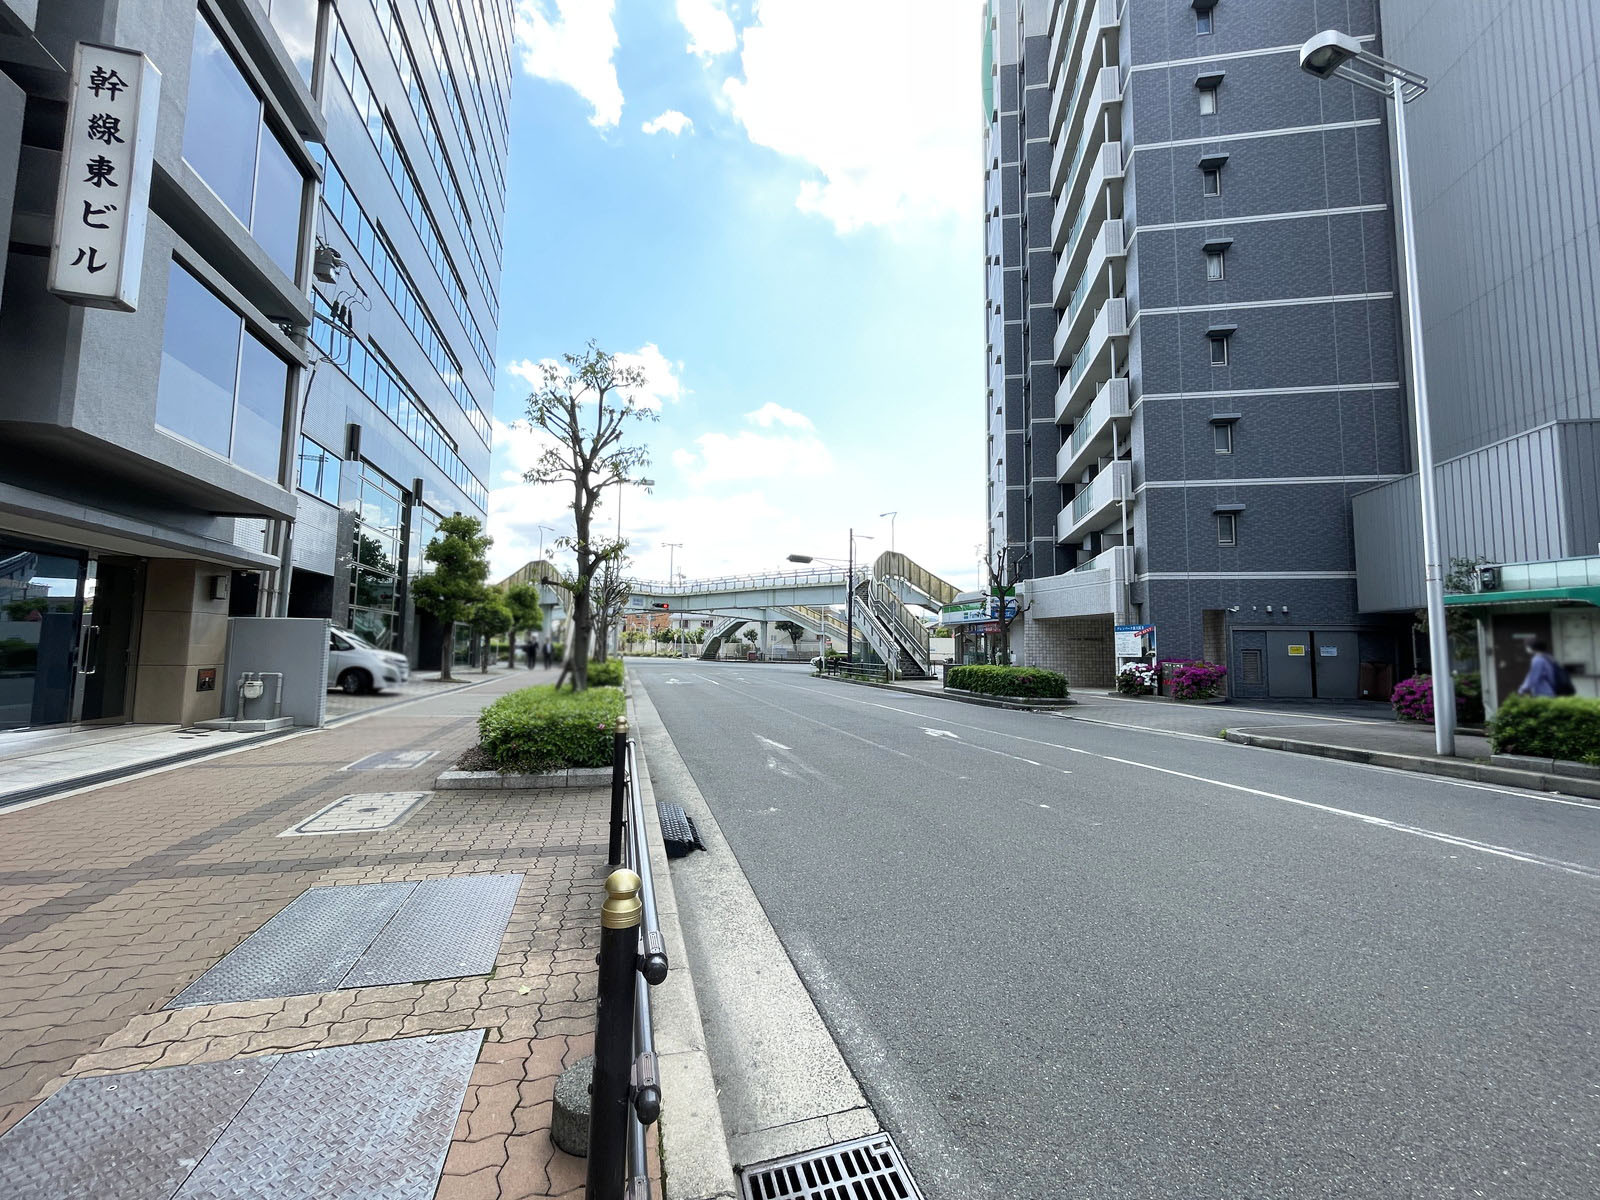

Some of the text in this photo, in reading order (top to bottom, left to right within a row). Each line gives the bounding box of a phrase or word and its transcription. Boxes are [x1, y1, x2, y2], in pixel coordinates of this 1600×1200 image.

[70, 66, 128, 274] 幹線東ビル
